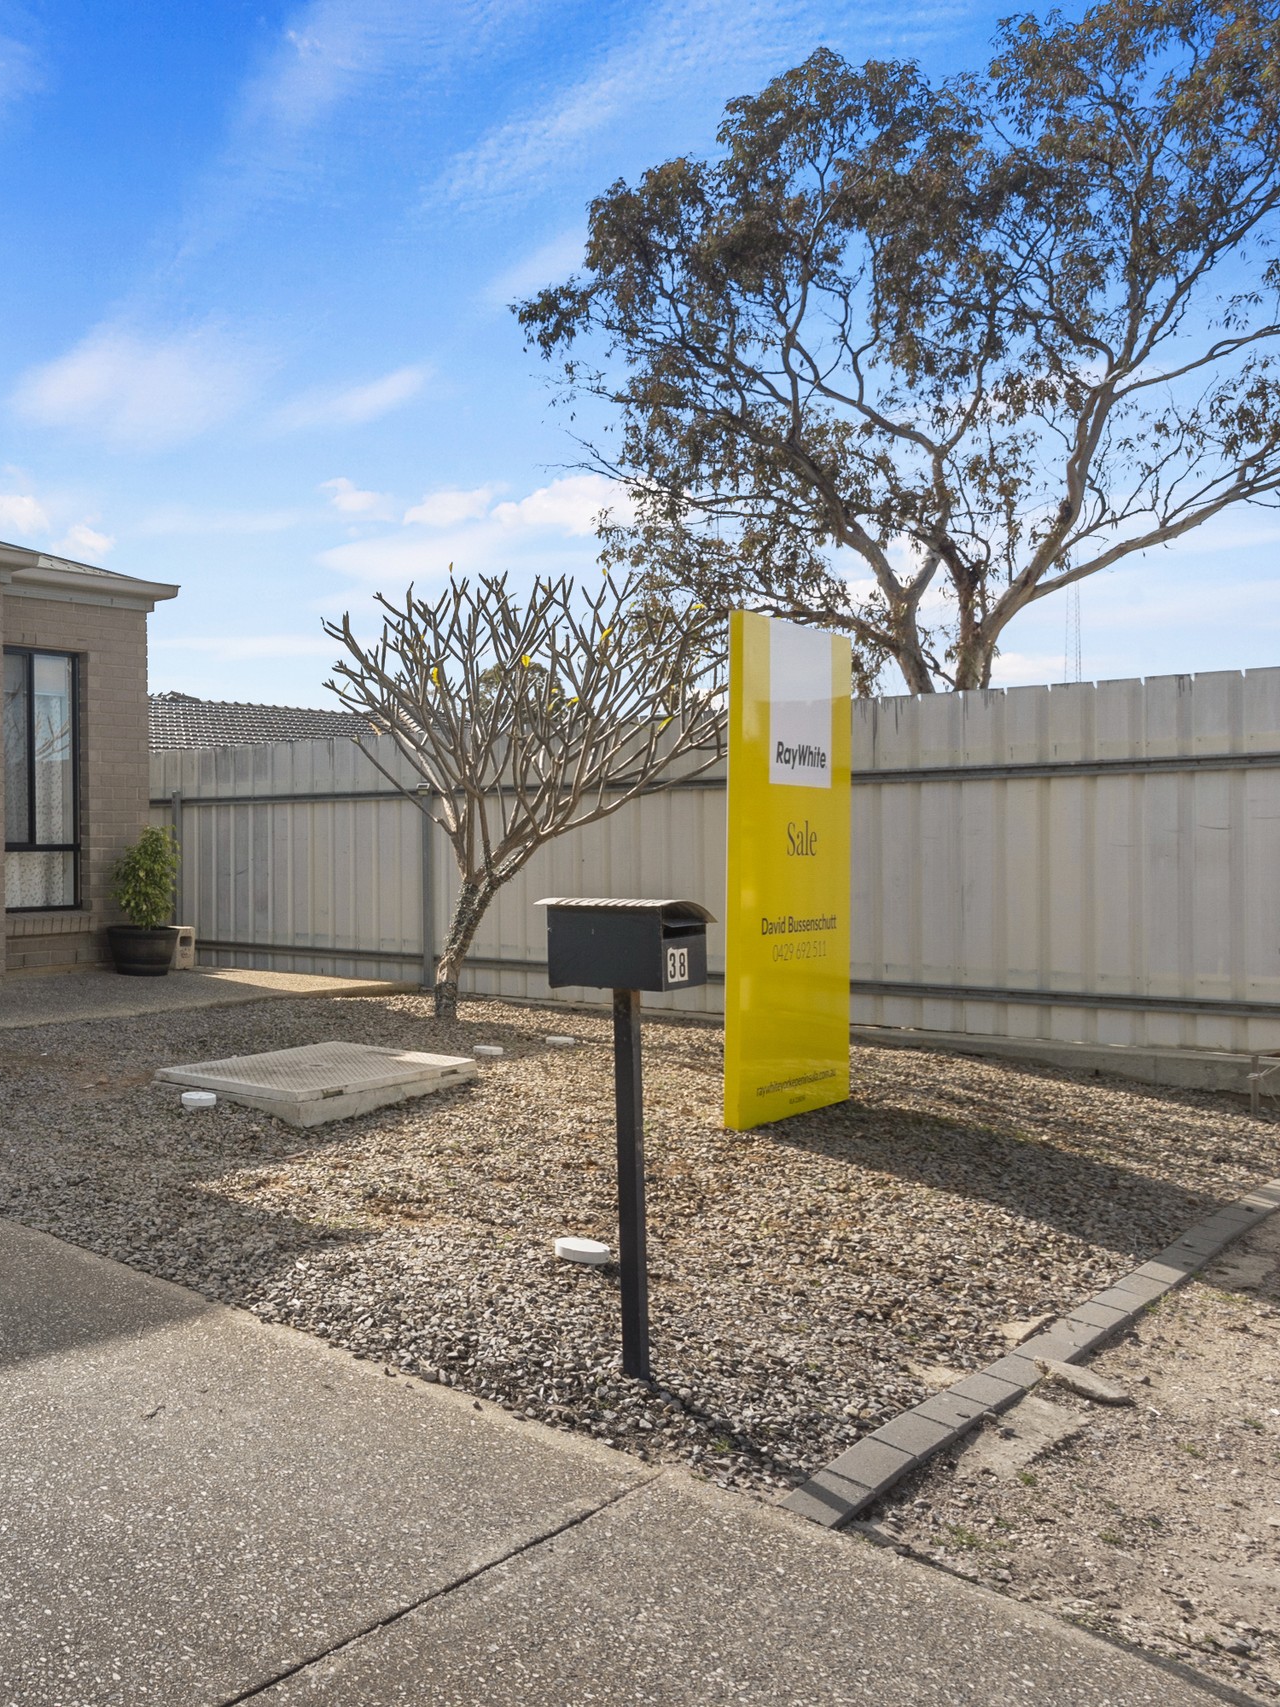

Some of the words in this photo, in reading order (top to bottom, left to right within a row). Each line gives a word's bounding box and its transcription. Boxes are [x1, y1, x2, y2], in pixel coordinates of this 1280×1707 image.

[787, 820, 818, 857] Sale
[761, 915, 786, 936] David
[788, 913, 837, 933] Bussenschutt
[772, 943, 794, 962] 0429
[796, 941, 811, 960] 692
[812, 940, 827, 957] 511
[669, 952, 687, 979] 38
